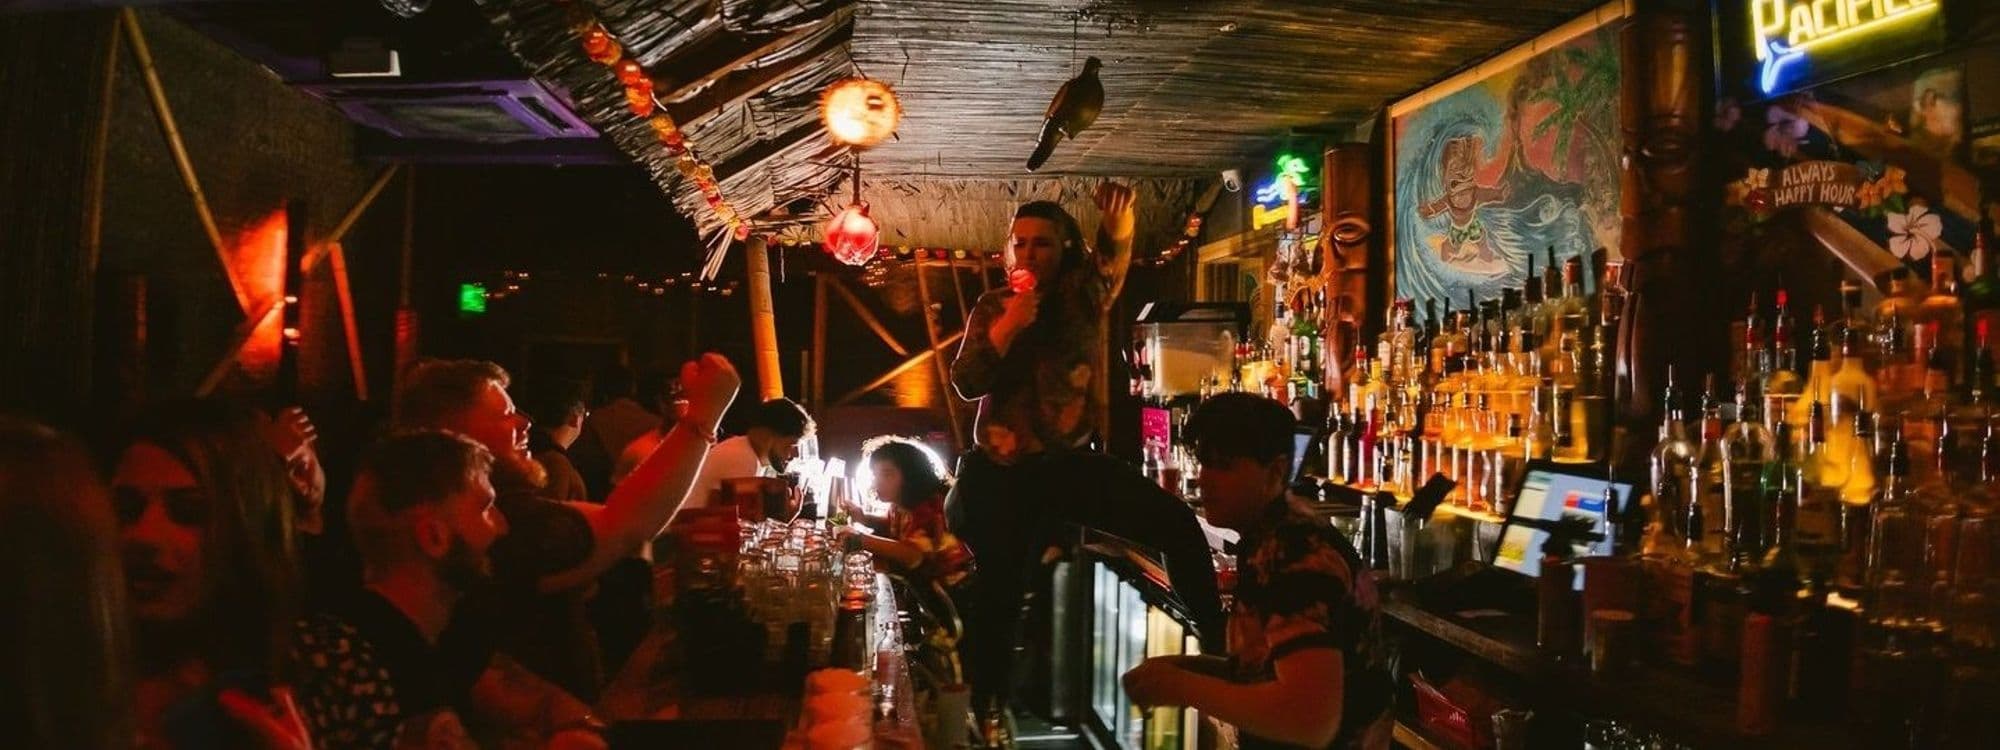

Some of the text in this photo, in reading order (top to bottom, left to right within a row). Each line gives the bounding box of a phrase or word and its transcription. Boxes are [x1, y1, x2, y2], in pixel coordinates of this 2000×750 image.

[1752, 0, 1938, 60] PACIFIC
[1782, 161, 1835, 187] ALWAYS
[1774, 184, 1855, 208] HAPPY HOUR
